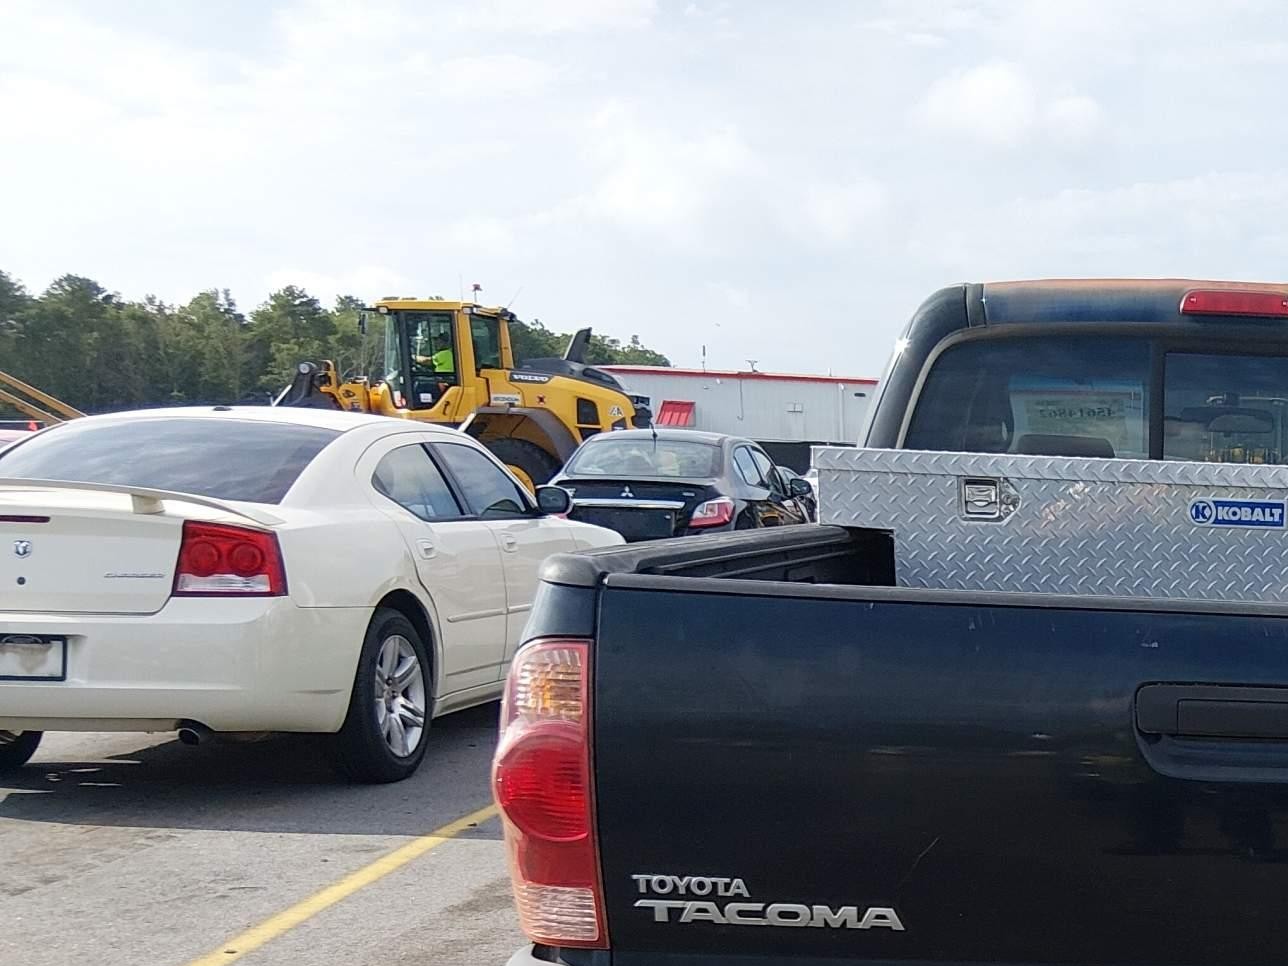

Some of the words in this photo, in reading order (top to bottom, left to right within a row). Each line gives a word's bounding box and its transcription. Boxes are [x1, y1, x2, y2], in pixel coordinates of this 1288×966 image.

[513, 374, 549, 382] VOLVO
[1217, 506, 1282, 523] KOBALT
[631, 874, 751, 898] TOYOTA
[633, 899, 905, 931] TACOMA
